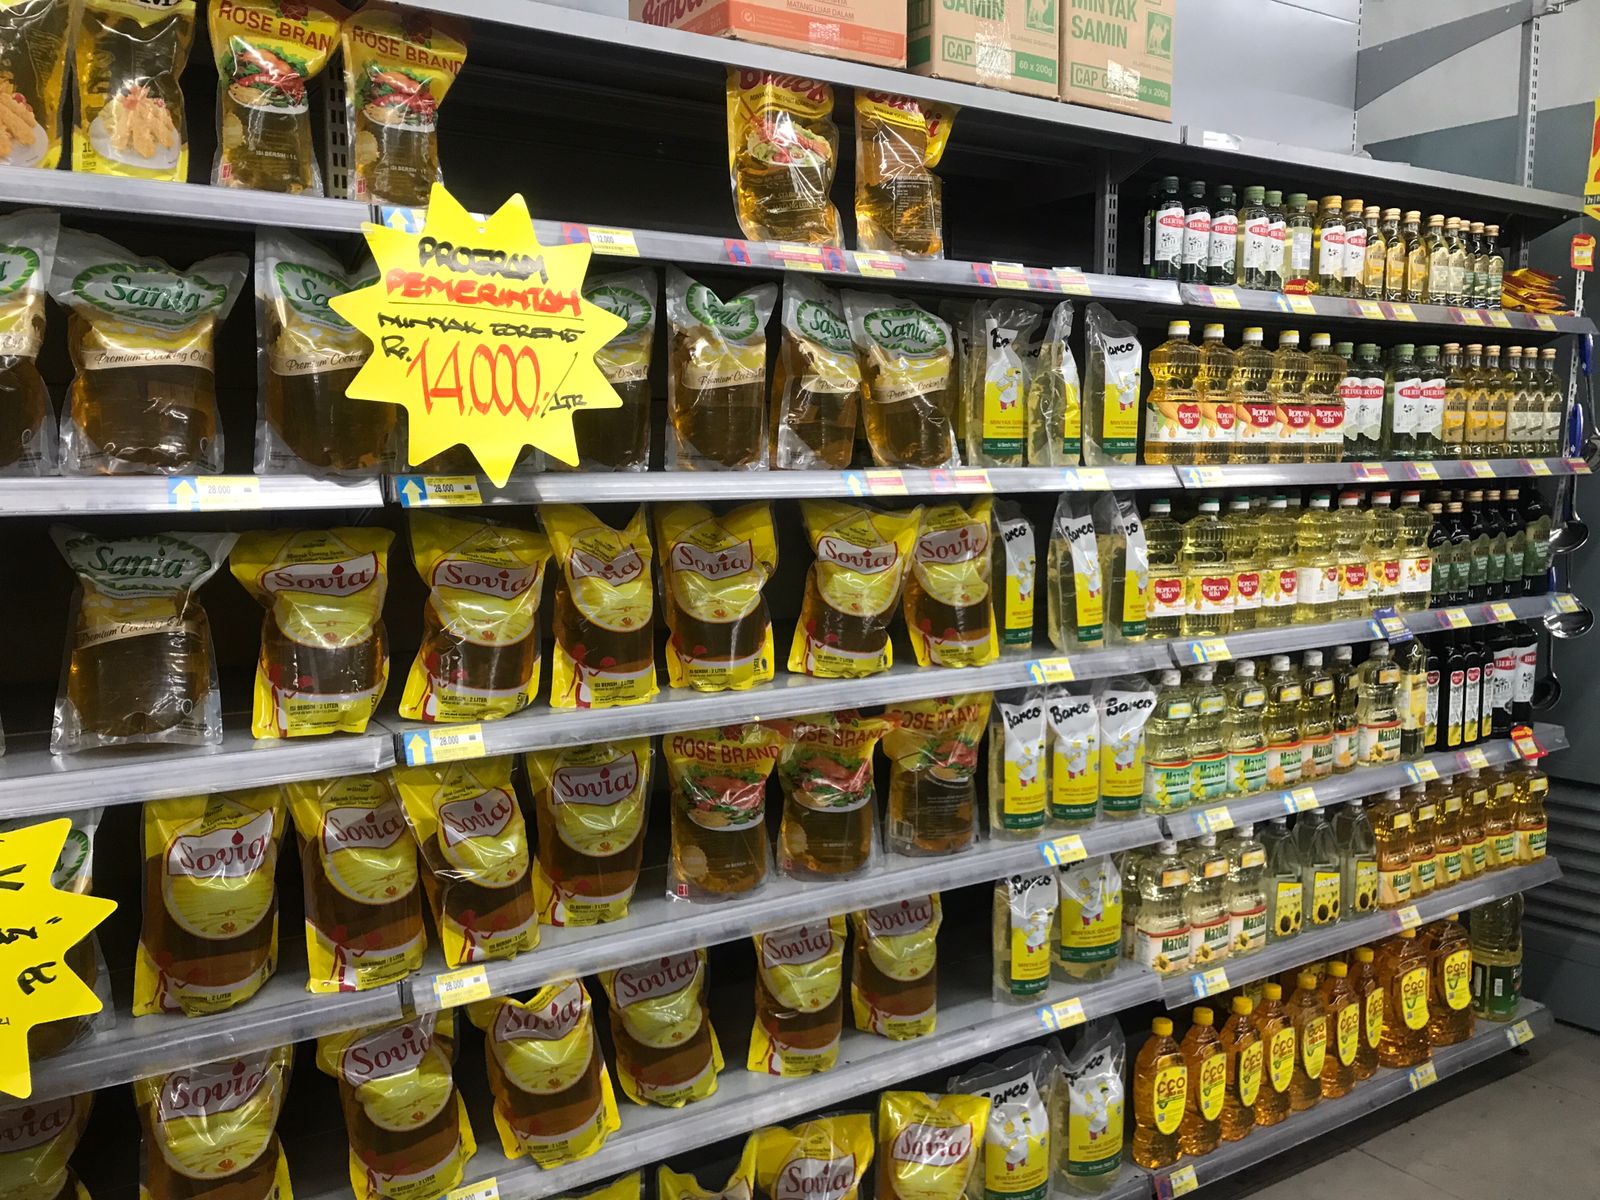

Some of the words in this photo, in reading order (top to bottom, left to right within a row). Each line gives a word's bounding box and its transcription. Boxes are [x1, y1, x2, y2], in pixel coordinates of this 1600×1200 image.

[218, 2, 274, 34] ROSE
[279, 22, 334, 51] BRAN
[1071, 14, 1129, 49] SAMIN
[352, 25, 401, 58] ROSE
[947, 40, 973, 61] CAP
[1018, 59, 1029, 70] 60
[1075, 68, 1098, 85] CAP
[104, 274, 206, 314] Sania
[879, 316, 930, 345] Sania
[95, 351, 141, 366] Premium
[434, 484, 455, 493] 28.000
[88, 546, 186, 580] Sania
[680, 545, 747, 574] Sovia
[825, 539, 890, 568] Sovia
[274, 564, 370, 590] Sovia
[444, 563, 530, 593] Sovia
[1005, 706, 1041, 730] Barco
[1049, 702, 1090, 726] Barco
[1105, 696, 1153, 717] Barco
[440, 735, 460, 747] 28.000
[672, 735, 718, 764] ROSE
[720, 742, 779, 765] BRAND
[558, 766, 632, 799] Sovia
[329, 811, 404, 842] Sovia
[443, 800, 511, 834] Sovia
[180, 831, 270, 871] Sovia
[869, 900, 930, 932] Sovia
[1243, 912, 1267, 931] Mazola
[766, 926, 829, 960] Sovia
[1162, 934, 1190, 953] Mazola
[1204, 924, 1229, 943] Mazola
[618, 957, 695, 998] Sovia
[784, 1162, 849, 1196] Sovia
